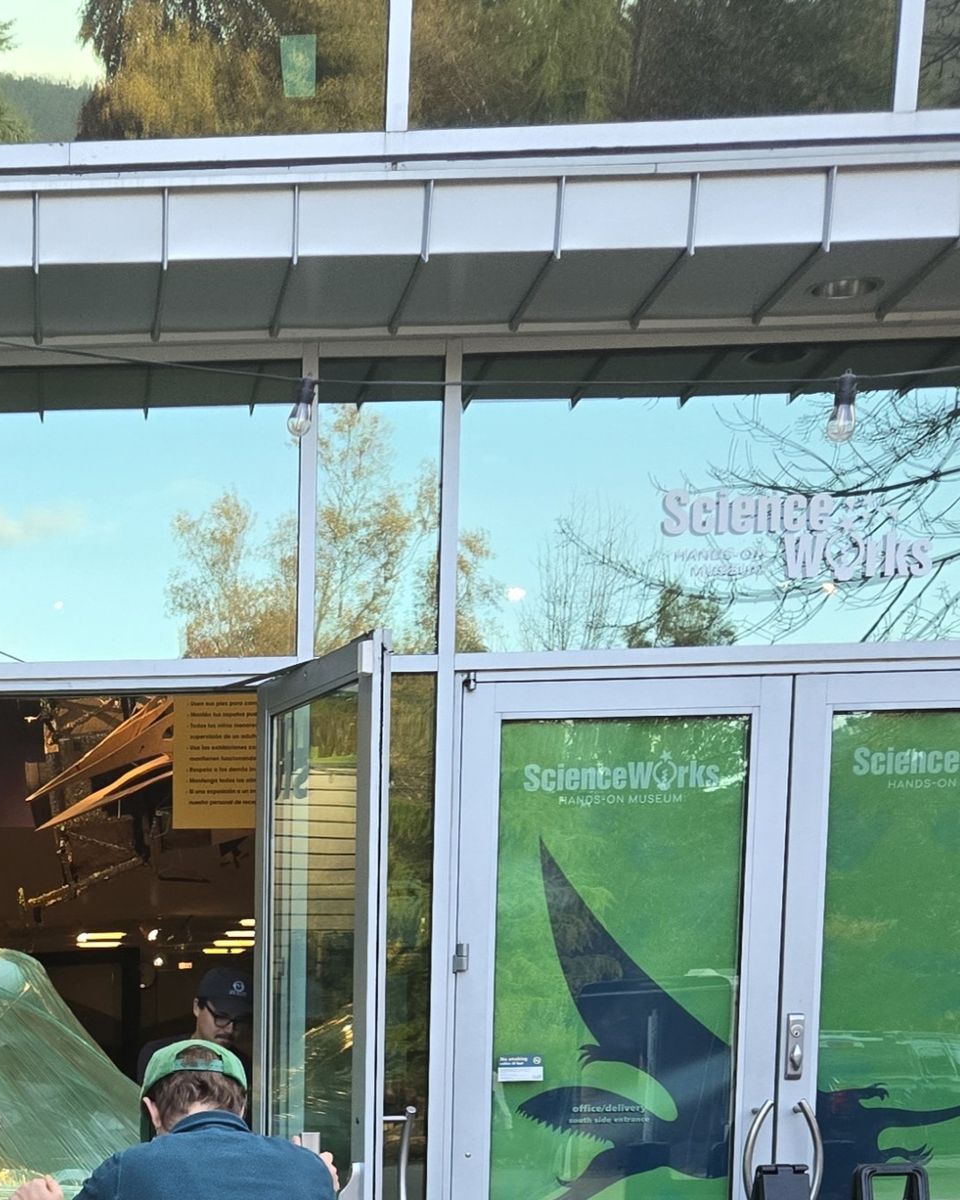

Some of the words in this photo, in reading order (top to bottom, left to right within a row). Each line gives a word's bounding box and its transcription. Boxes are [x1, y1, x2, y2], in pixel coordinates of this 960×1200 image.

[662, 488, 834, 536] Science
[852, 746, 960, 776] Science
[523, 760, 721, 791] ScienceWorks
[887, 778, 958, 790] HANDS-ON
[558, 794, 625, 806] HANDS-ON
[628, 793, 683, 804] MUSEUM
[571, 1103, 646, 1114] office/delivery
[594, 1115, 612, 1123] side
